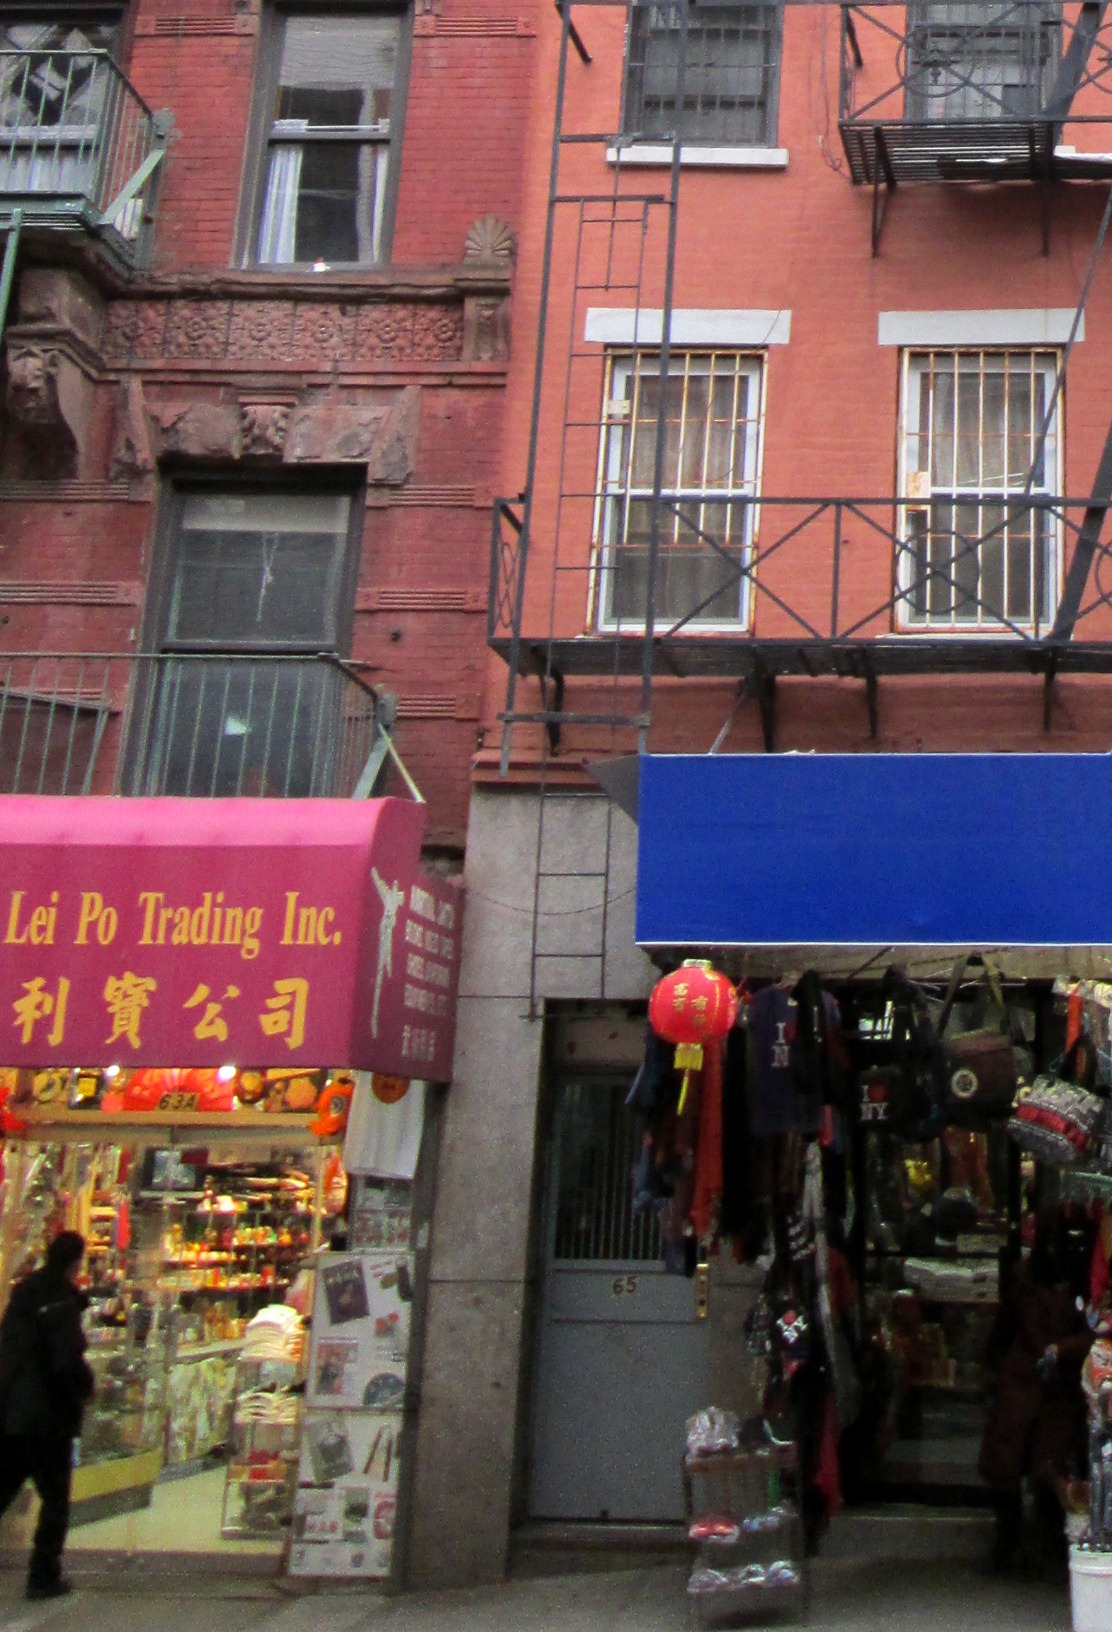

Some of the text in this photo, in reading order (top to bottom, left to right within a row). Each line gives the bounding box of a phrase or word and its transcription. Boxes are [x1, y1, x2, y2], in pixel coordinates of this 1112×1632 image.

[4, 891, 60, 945] Lei
[75, 891, 118, 945] Po
[138, 891, 264, 960] Trading
[280, 891, 343, 946] Inc.
[13, 971, 310, 1050] 利寶公司
[159, 1093, 197, 1110] 63A
[861, 1102, 889, 1121] NY
[612, 1276, 638, 1296] 65
